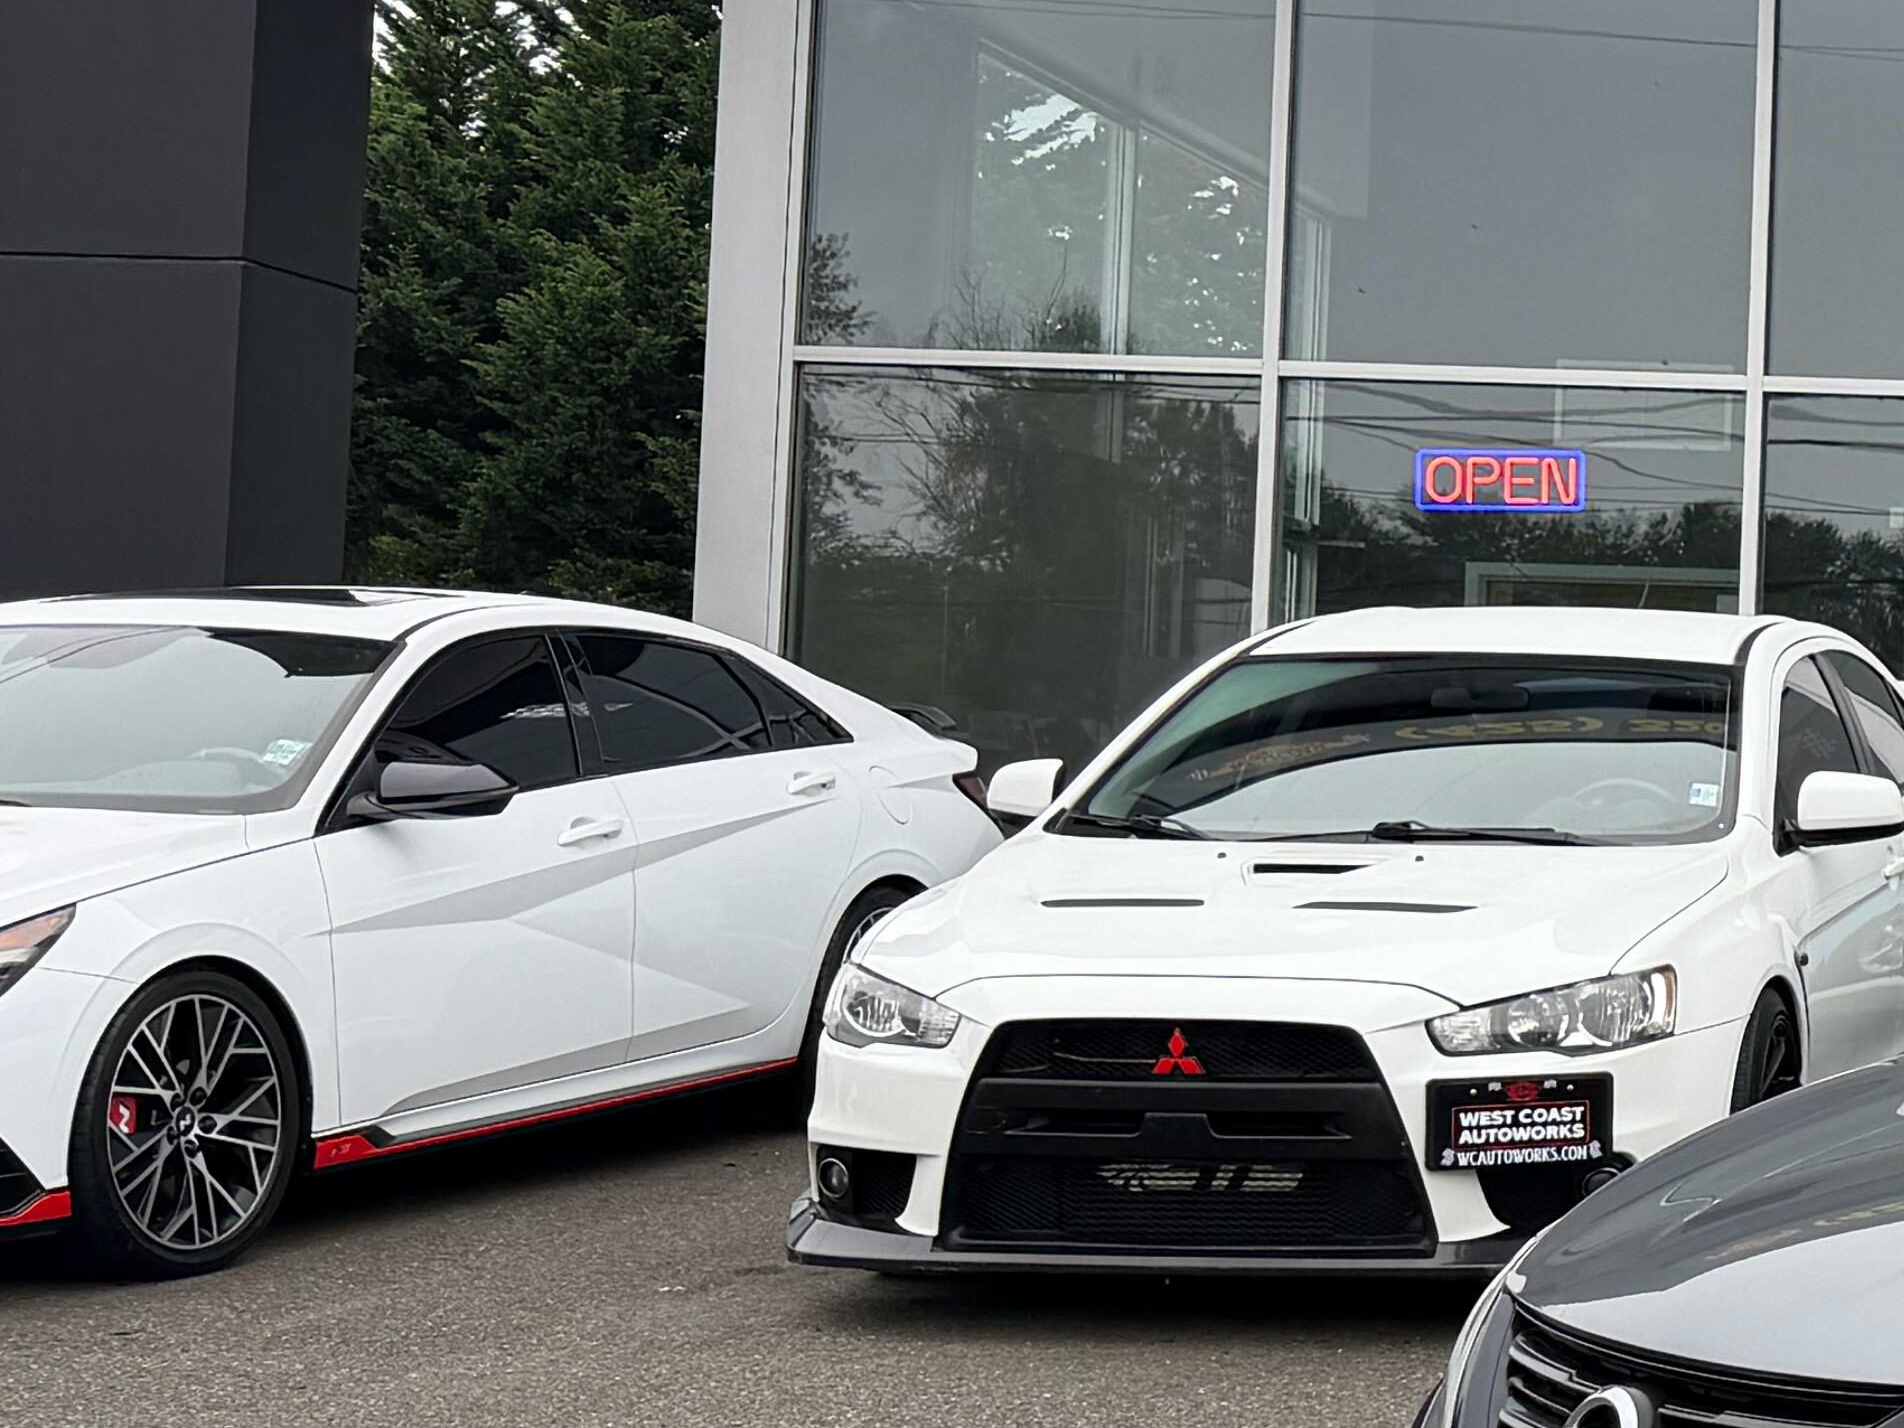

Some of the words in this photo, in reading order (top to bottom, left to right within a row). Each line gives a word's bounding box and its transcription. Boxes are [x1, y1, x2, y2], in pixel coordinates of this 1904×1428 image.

[1425, 456, 1577, 505] OPEN
[1458, 1109, 1516, 1128] WEST
[1517, 1105, 1586, 1124] COAST
[1457, 1122, 1586, 1146] AUTOWORKS
[1456, 1144, 1588, 1167] WCAUTOWORKS.COM
